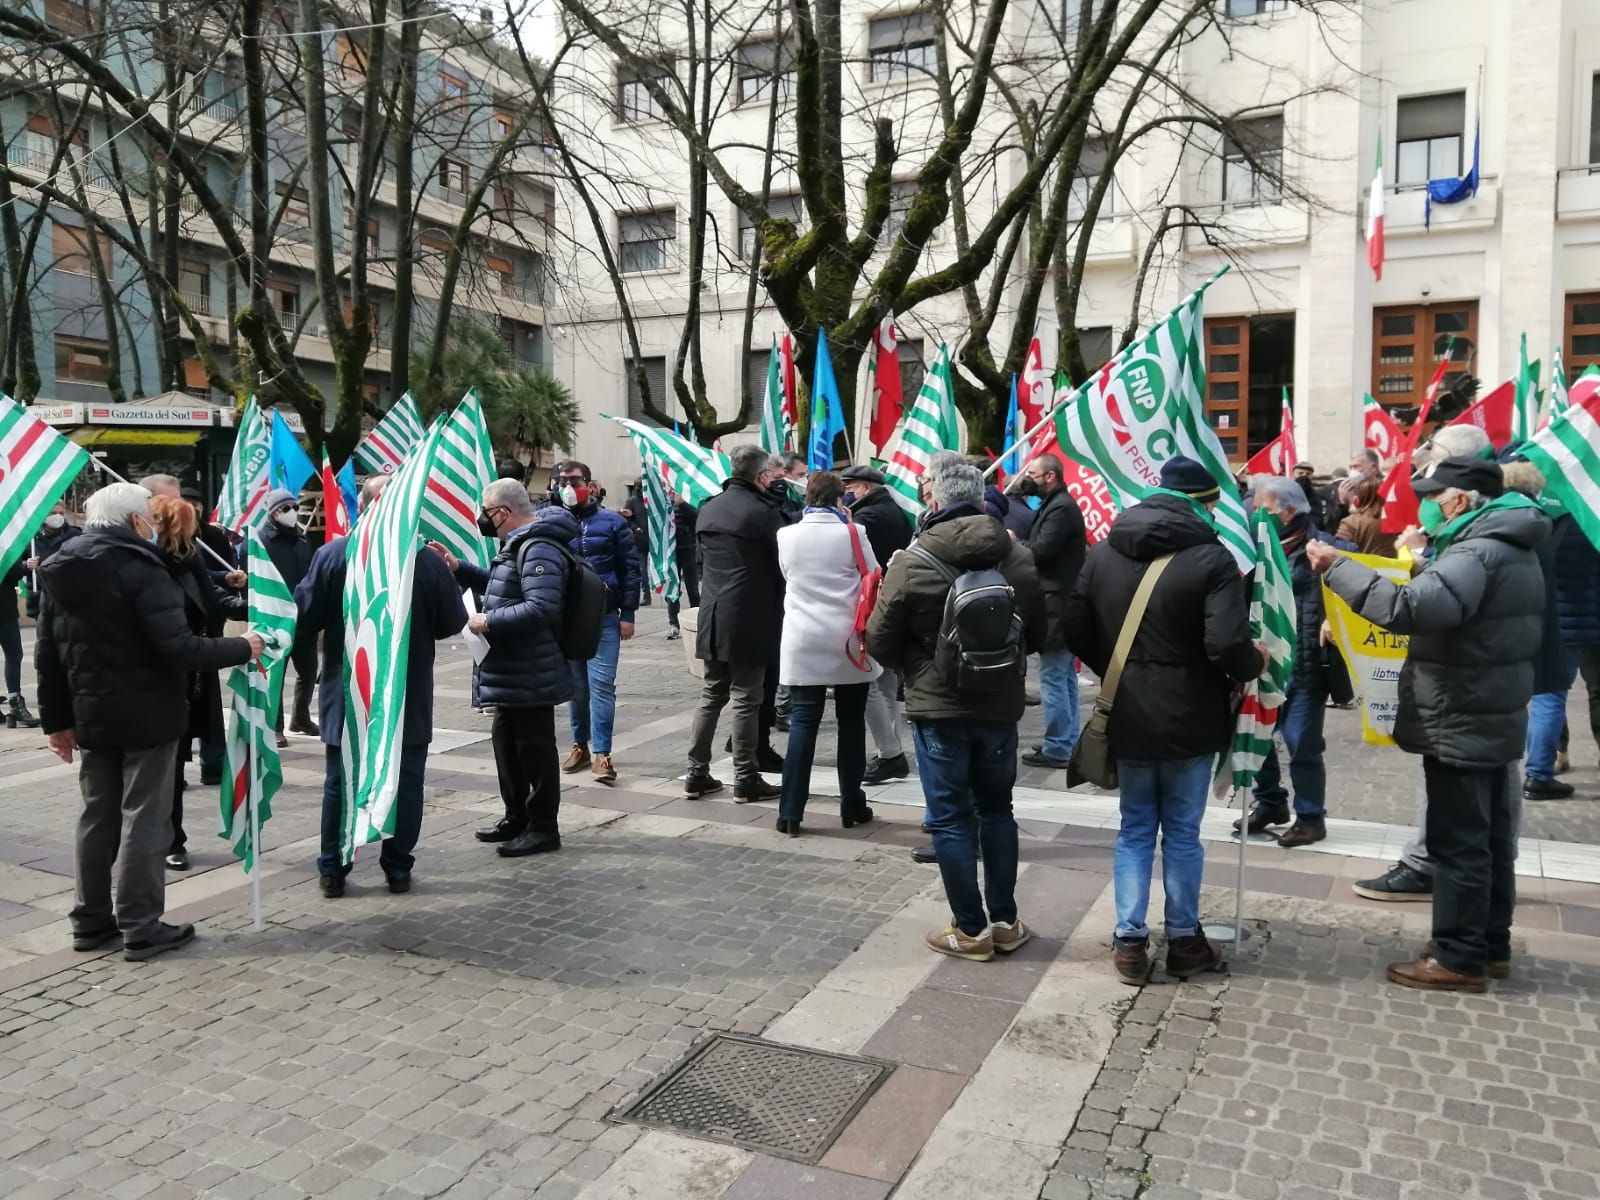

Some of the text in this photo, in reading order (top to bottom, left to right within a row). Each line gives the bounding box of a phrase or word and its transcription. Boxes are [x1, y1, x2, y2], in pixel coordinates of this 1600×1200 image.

[1127, 365, 1156, 409] FNP
[111, 409, 154, 419] Gazzetta
[155, 409, 169, 419] del
[171, 410, 190, 419] Sud
